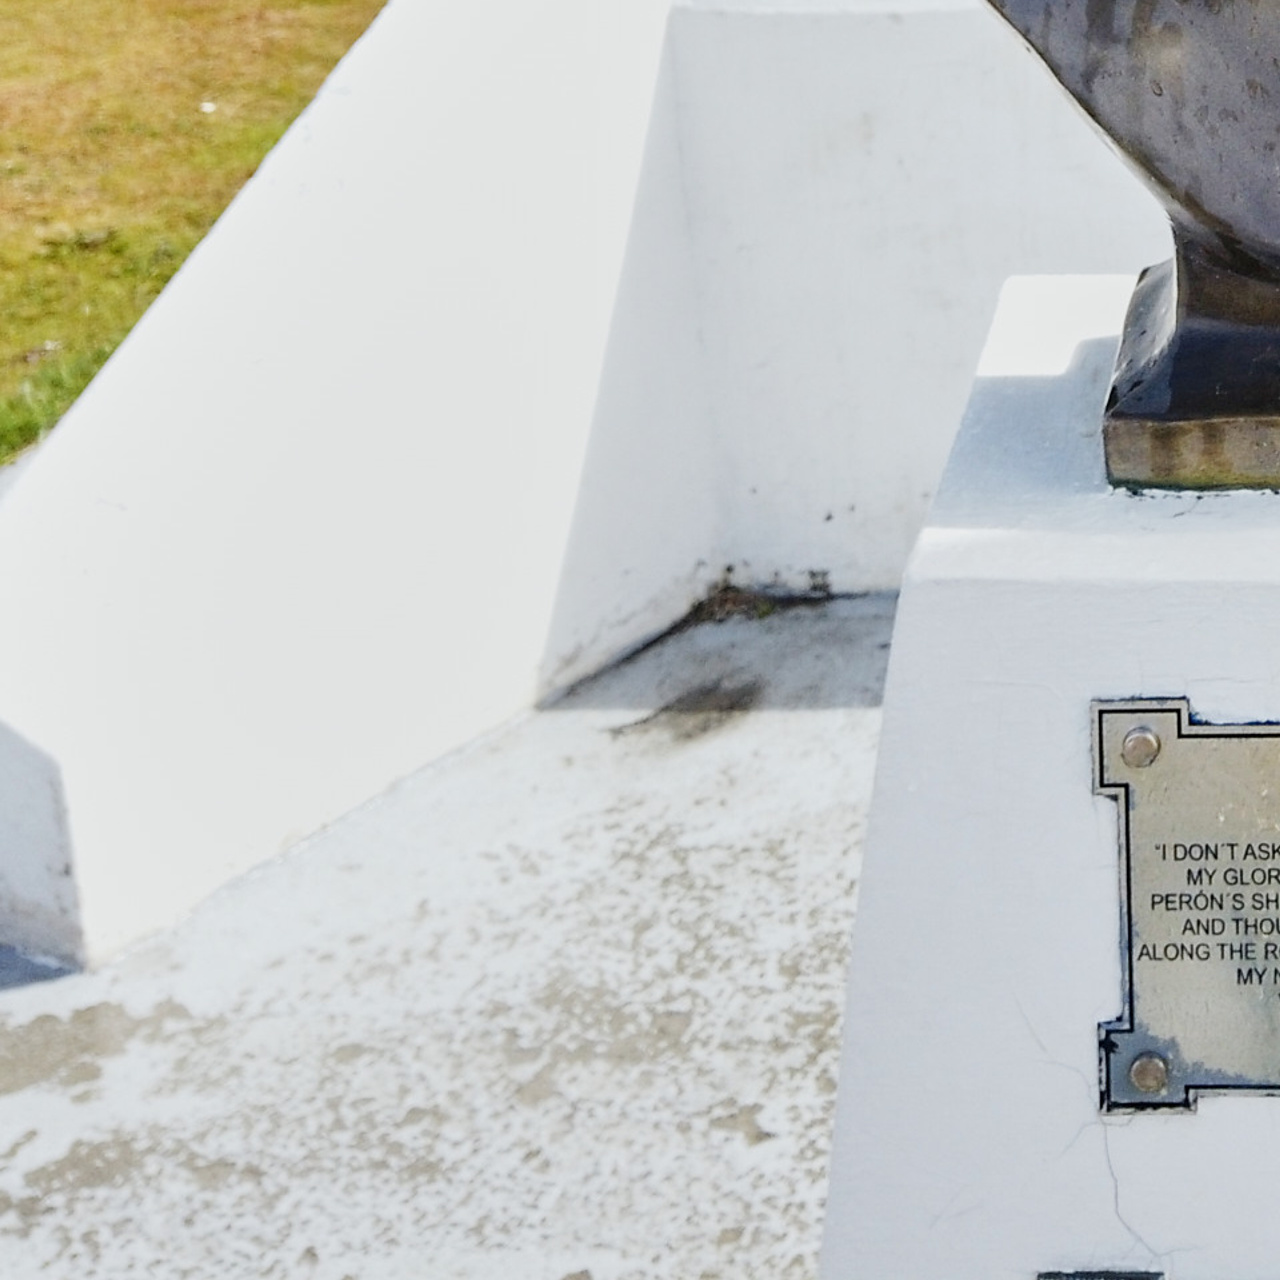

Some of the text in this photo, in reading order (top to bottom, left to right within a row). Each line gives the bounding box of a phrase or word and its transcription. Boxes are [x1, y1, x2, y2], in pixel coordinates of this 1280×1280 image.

[1186, 865, 1217, 886] MY
[1181, 916, 1226, 936] AND
[1136, 943, 1211, 962] ALONG
[1216, 941, 1257, 961] THE
[1236, 966, 1268, 986] MY
